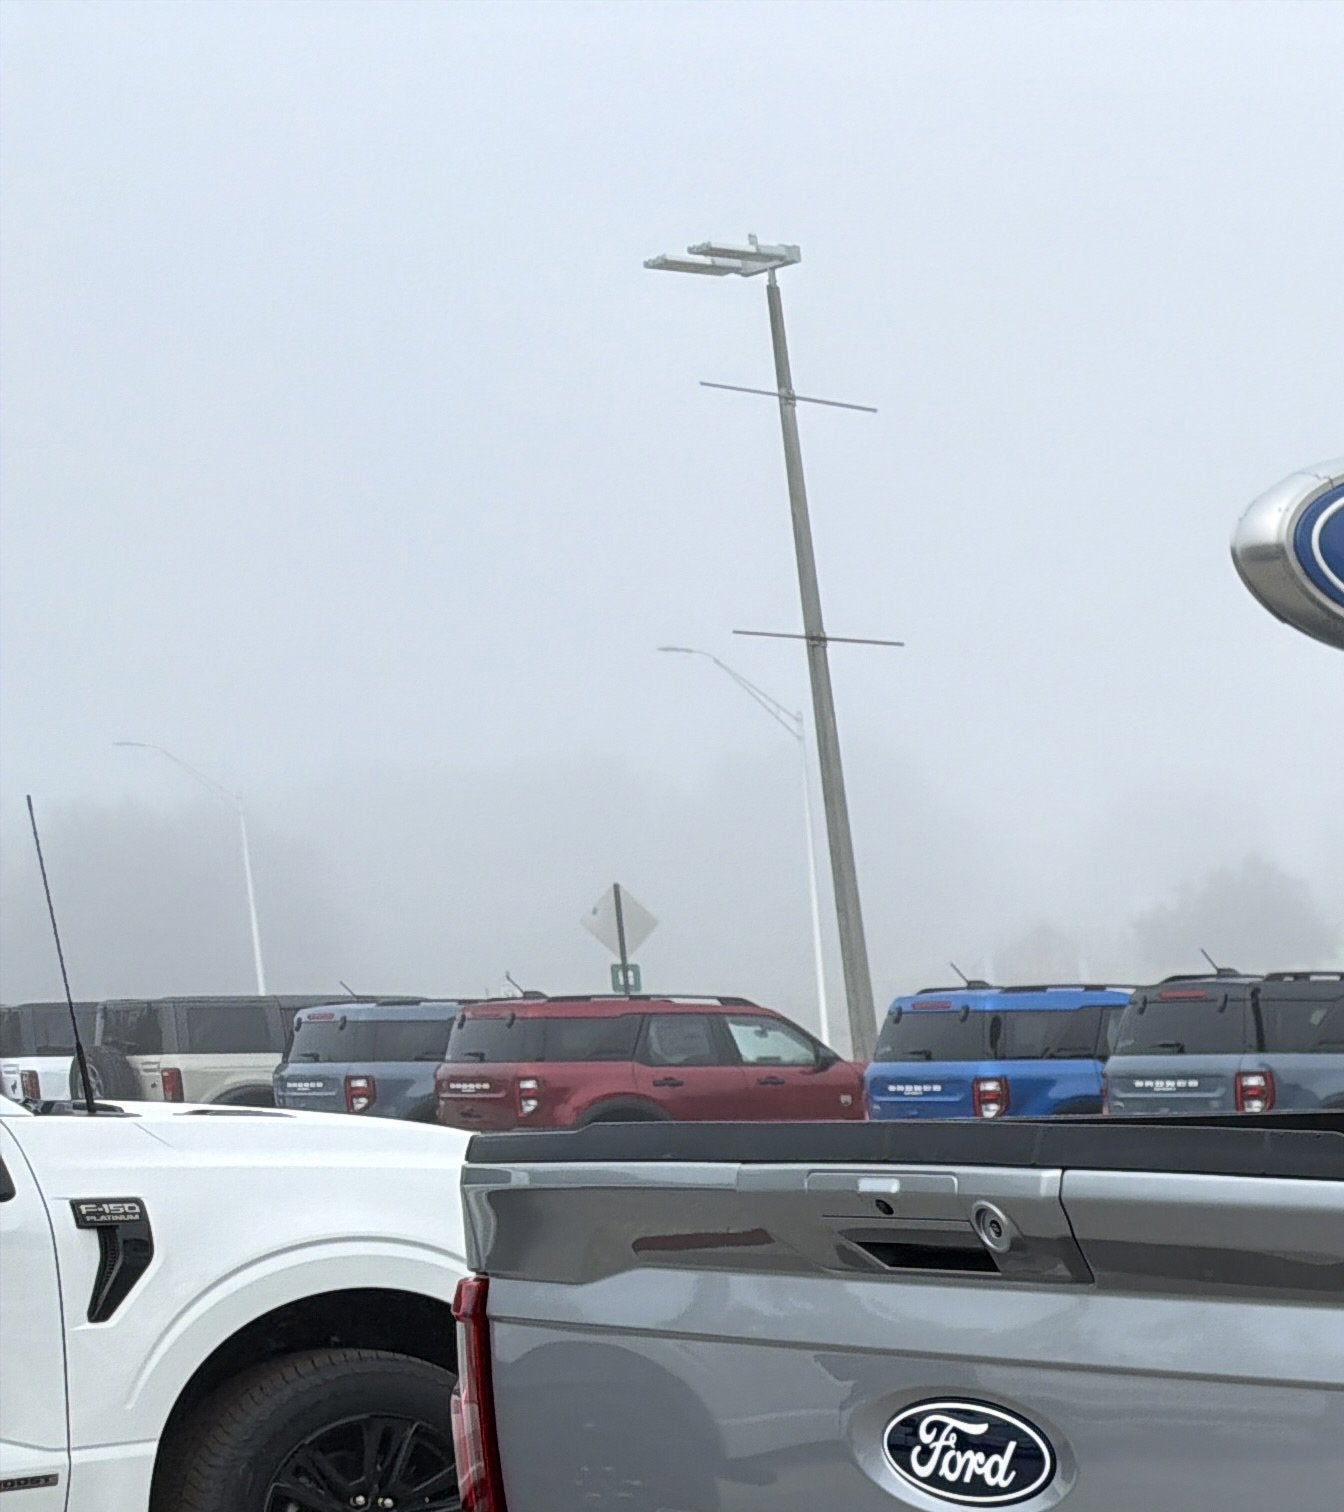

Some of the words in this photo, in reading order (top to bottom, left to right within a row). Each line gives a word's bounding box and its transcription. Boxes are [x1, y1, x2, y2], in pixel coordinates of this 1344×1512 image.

[79, 1202, 141, 1215] F-150
[85, 1214, 140, 1222] PLATINUM
[910, 1414, 1018, 1489] Ford
